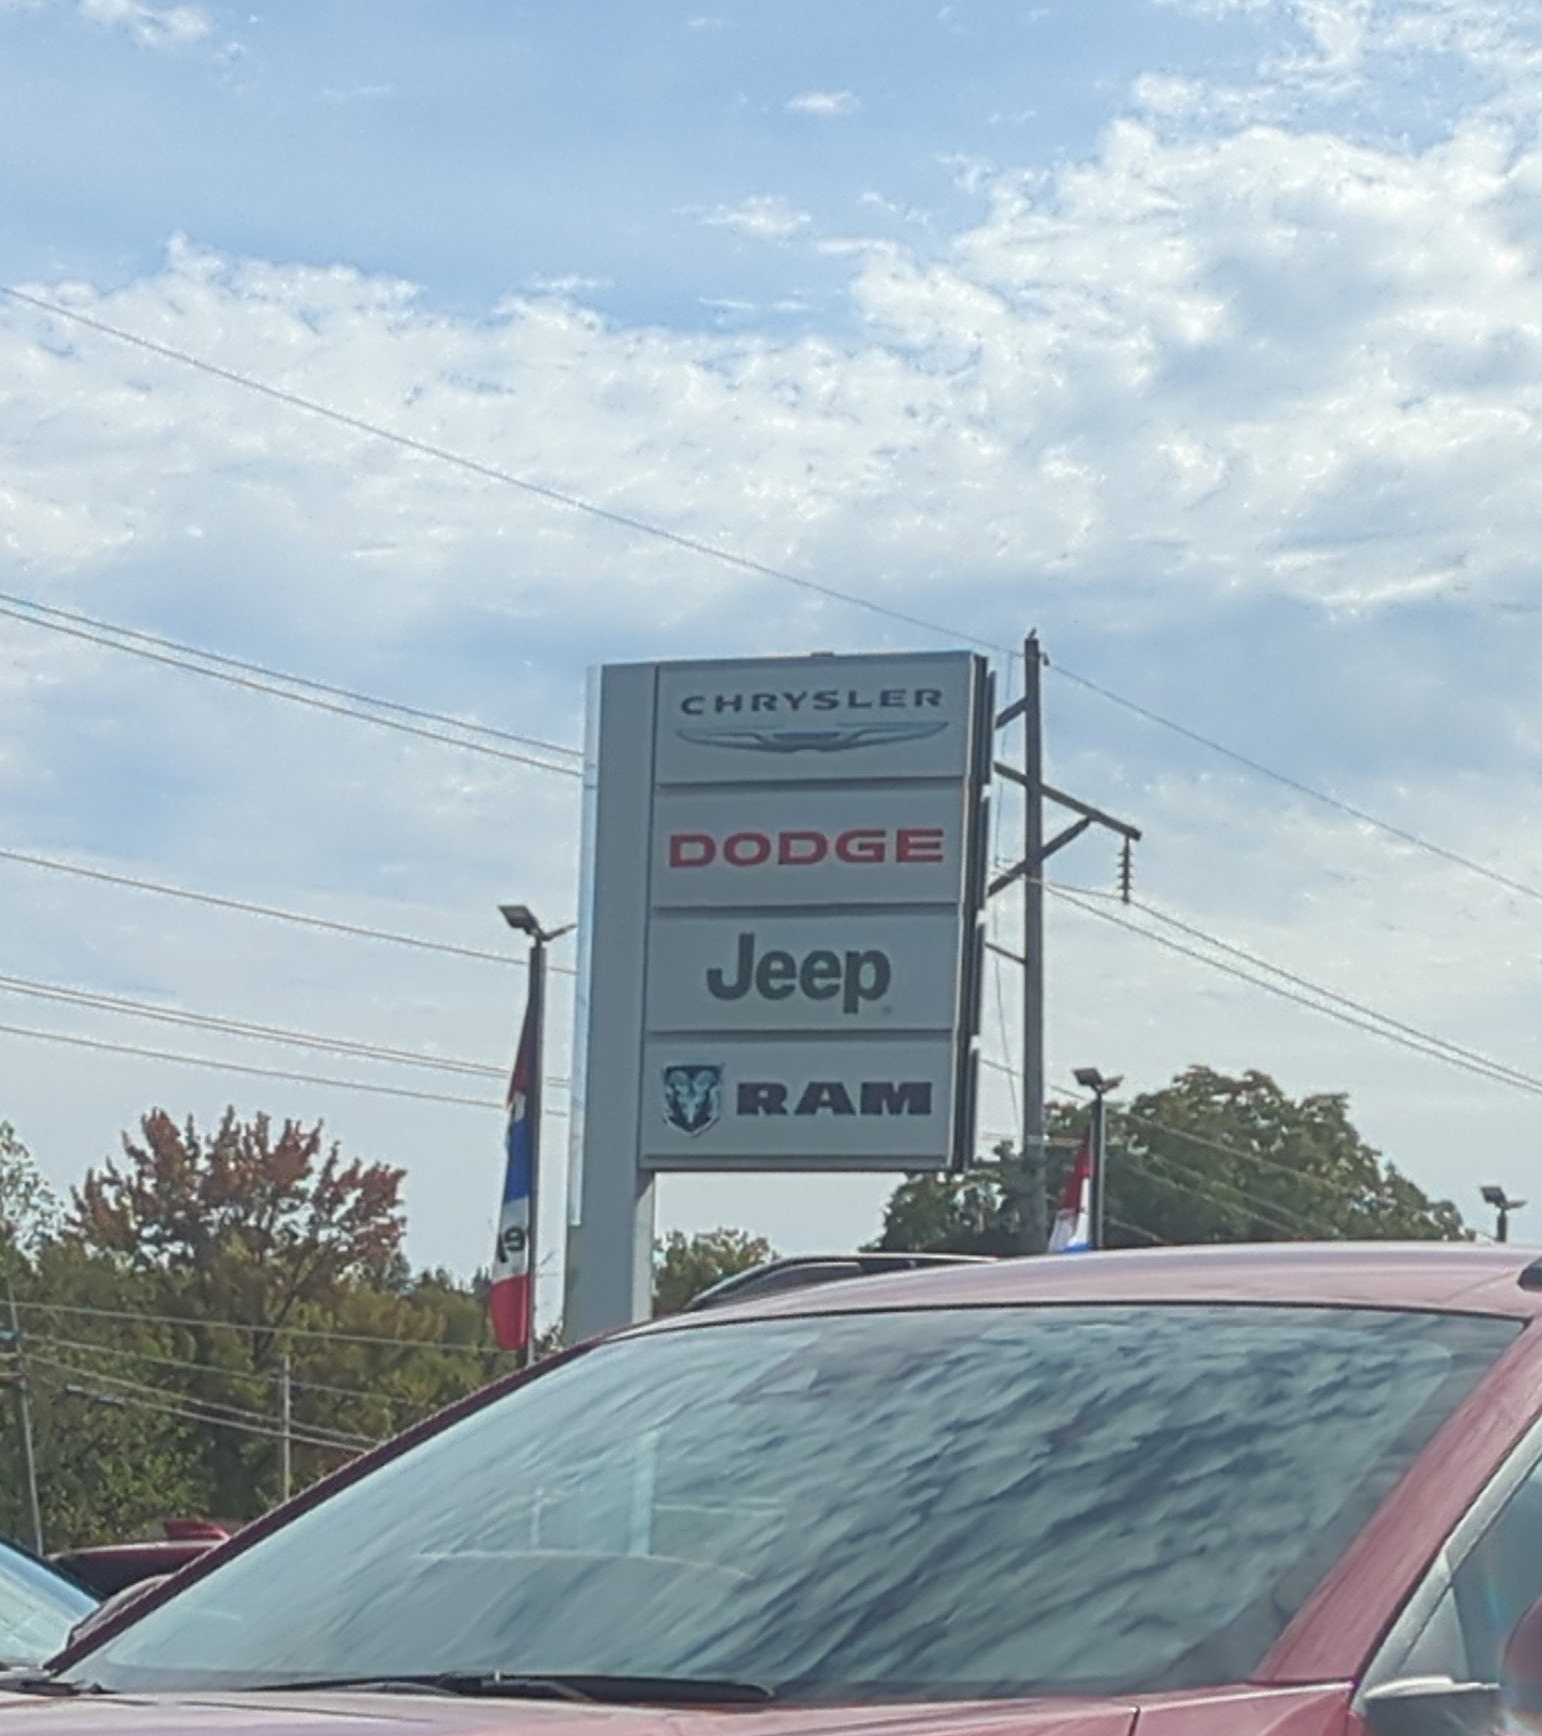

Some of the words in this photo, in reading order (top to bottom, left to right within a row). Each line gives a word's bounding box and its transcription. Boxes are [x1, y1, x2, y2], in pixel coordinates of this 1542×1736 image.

[680, 688, 943, 716] CHRYSLER
[669, 828, 945, 868] DODGE
[706, 932, 892, 1014] Jeep
[736, 1082, 932, 1116] RAM
